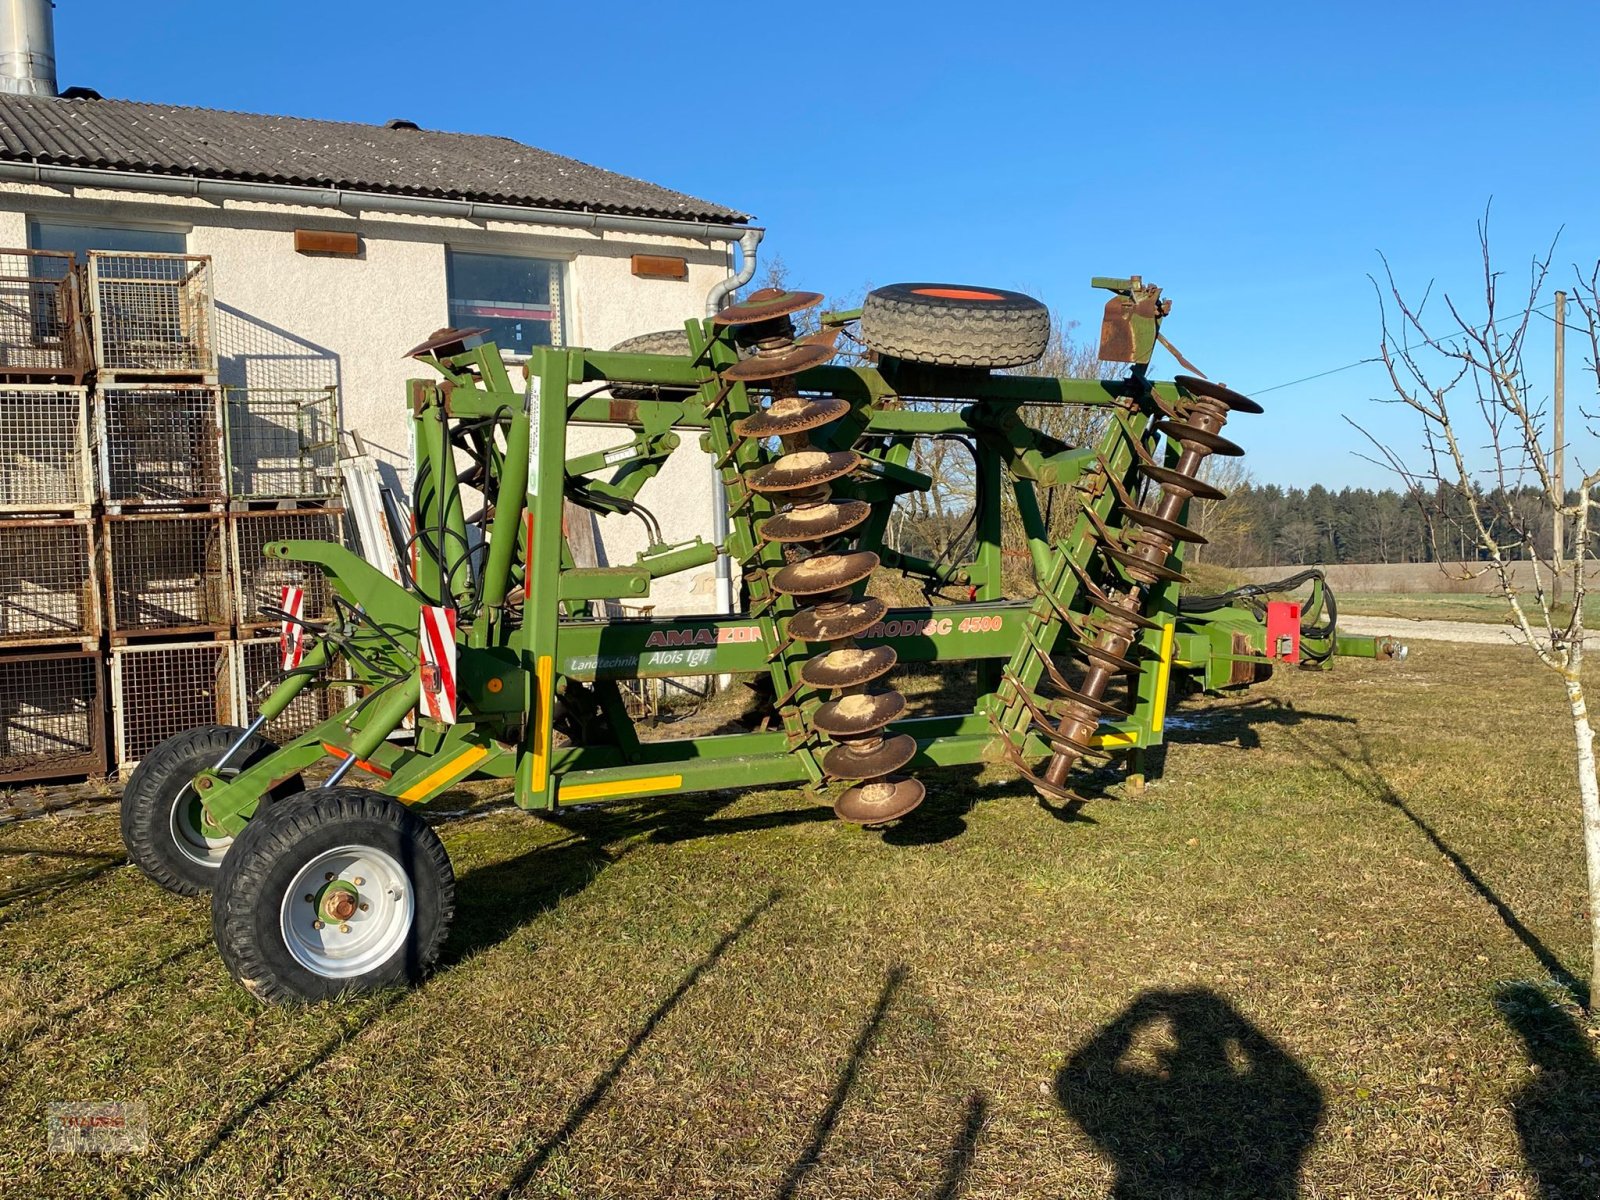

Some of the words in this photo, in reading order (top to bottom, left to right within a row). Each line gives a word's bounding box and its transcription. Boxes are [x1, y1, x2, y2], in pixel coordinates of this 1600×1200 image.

[958, 616, 1002, 633] 4500
[645, 626, 778, 647] AMAZON
[570, 656, 639, 671] Landtechnik
[648, 650, 683, 665] Alois
